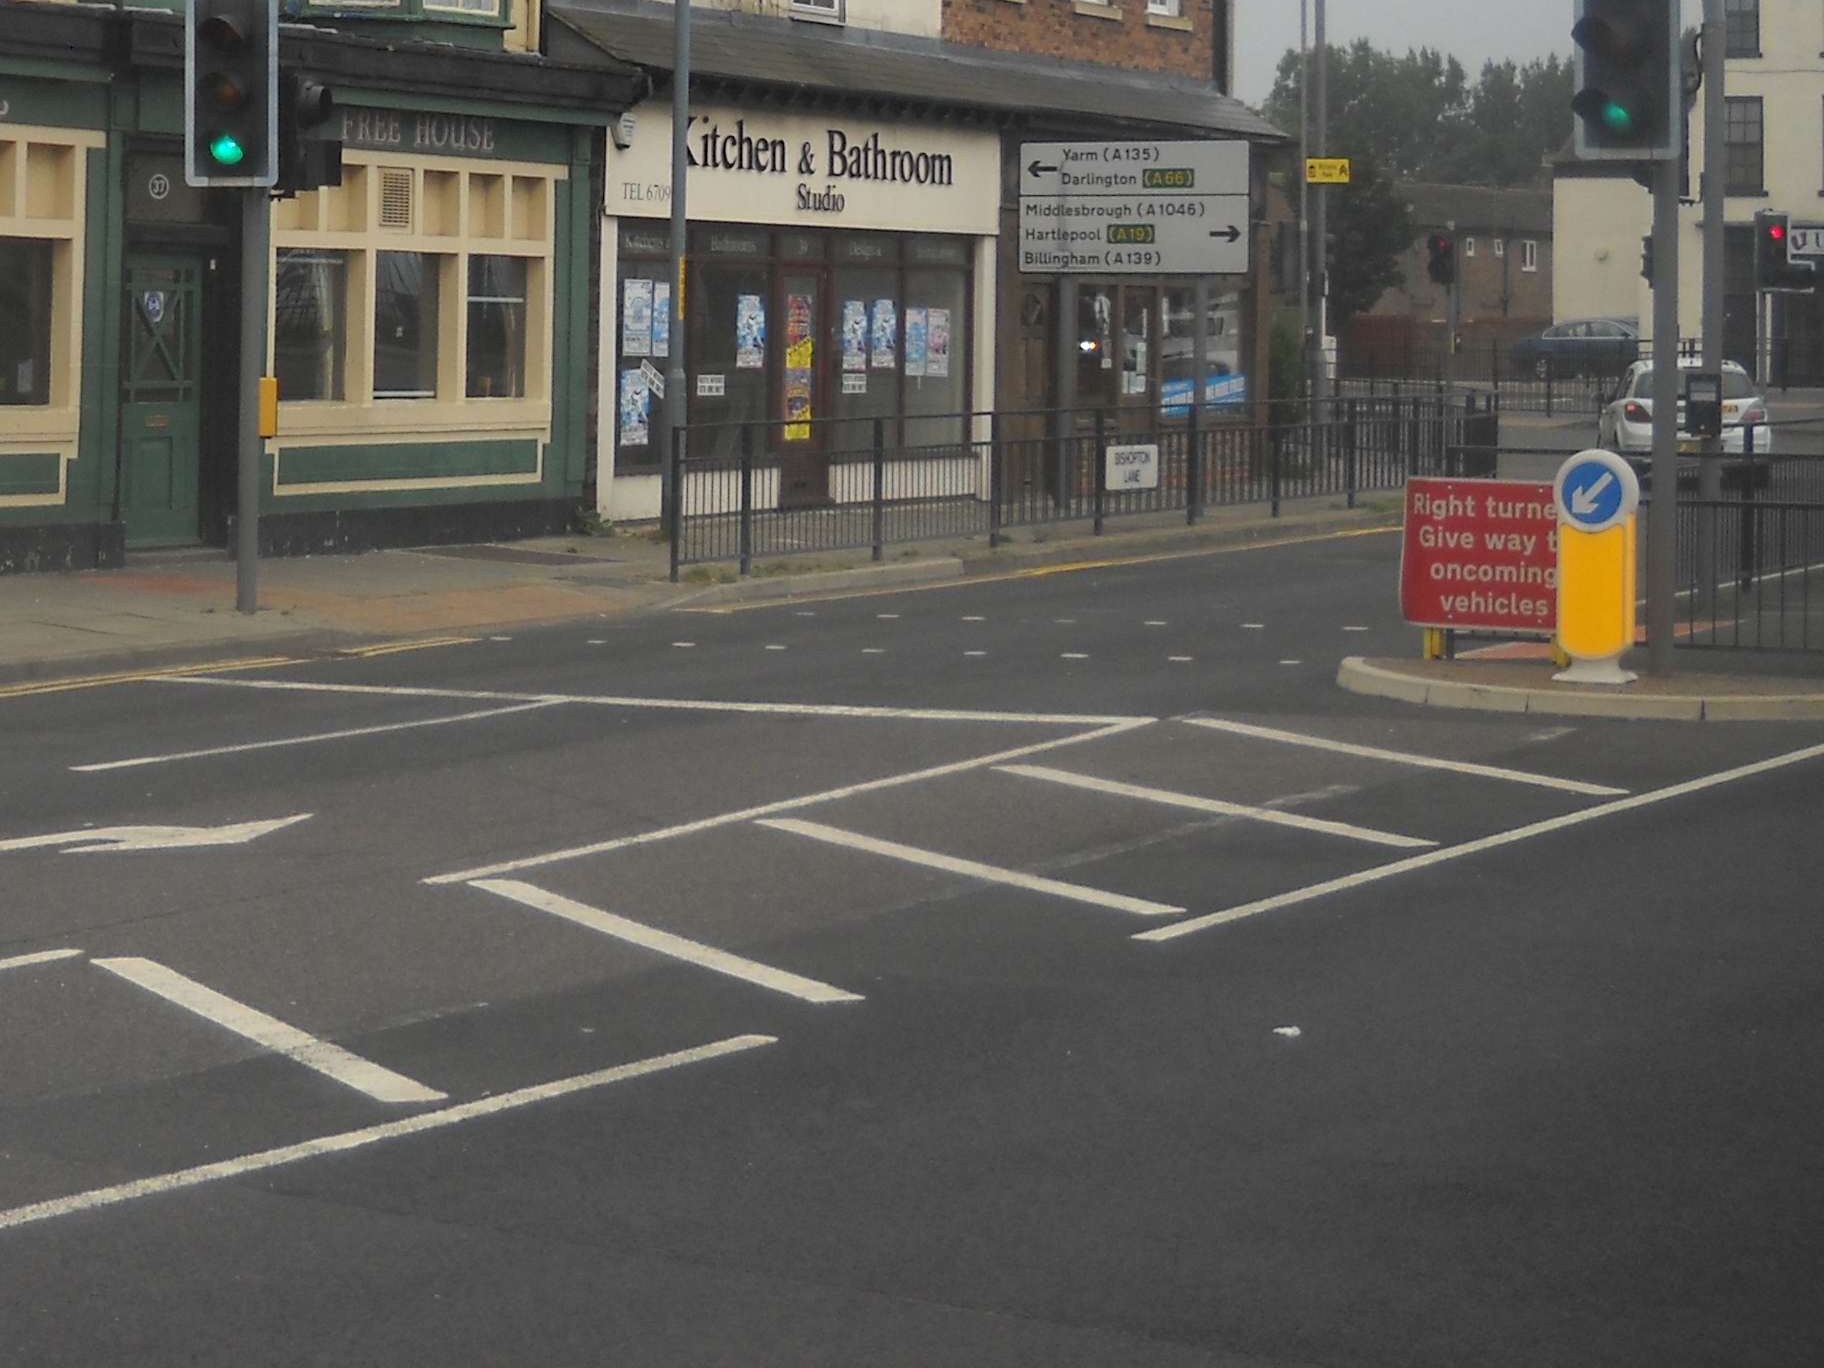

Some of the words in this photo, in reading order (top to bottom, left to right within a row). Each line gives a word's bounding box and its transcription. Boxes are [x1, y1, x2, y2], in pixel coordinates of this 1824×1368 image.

[341, 108, 401, 145] FREE
[413, 113, 495, 152] HOUSE
[798, 141, 816, 175] &
[827, 130, 953, 185] Bathroom
[1062, 148, 1098, 161] Yarm
[1103, 147, 1160, 162] (A135)
[1061, 172, 1137, 187] Darlington
[1144, 170, 1194, 187] (A66)
[622, 182, 643, 201] TEL
[646, 184, 671, 201] 6709
[796, 183, 845, 212] Studio
[1026, 203, 1131, 218] Middlesbrough
[1137, 202, 1206, 218] (A1046)
[1025, 229, 1101, 241] Hartlepool
[1108, 225, 1154, 243] (A19)
[1025, 251, 1100, 267] Billingham
[1104, 250, 1162, 266] (A139)
[1414, 493, 1476, 520] Right
[1486, 496, 1557, 519] turne
[1419, 525, 1474, 548] Give
[1485, 533, 1537, 556] way
[1547, 531, 1557, 552] t
[1430, 561, 1557, 589] oncoming
[1440, 591, 1548, 616] vehicles
